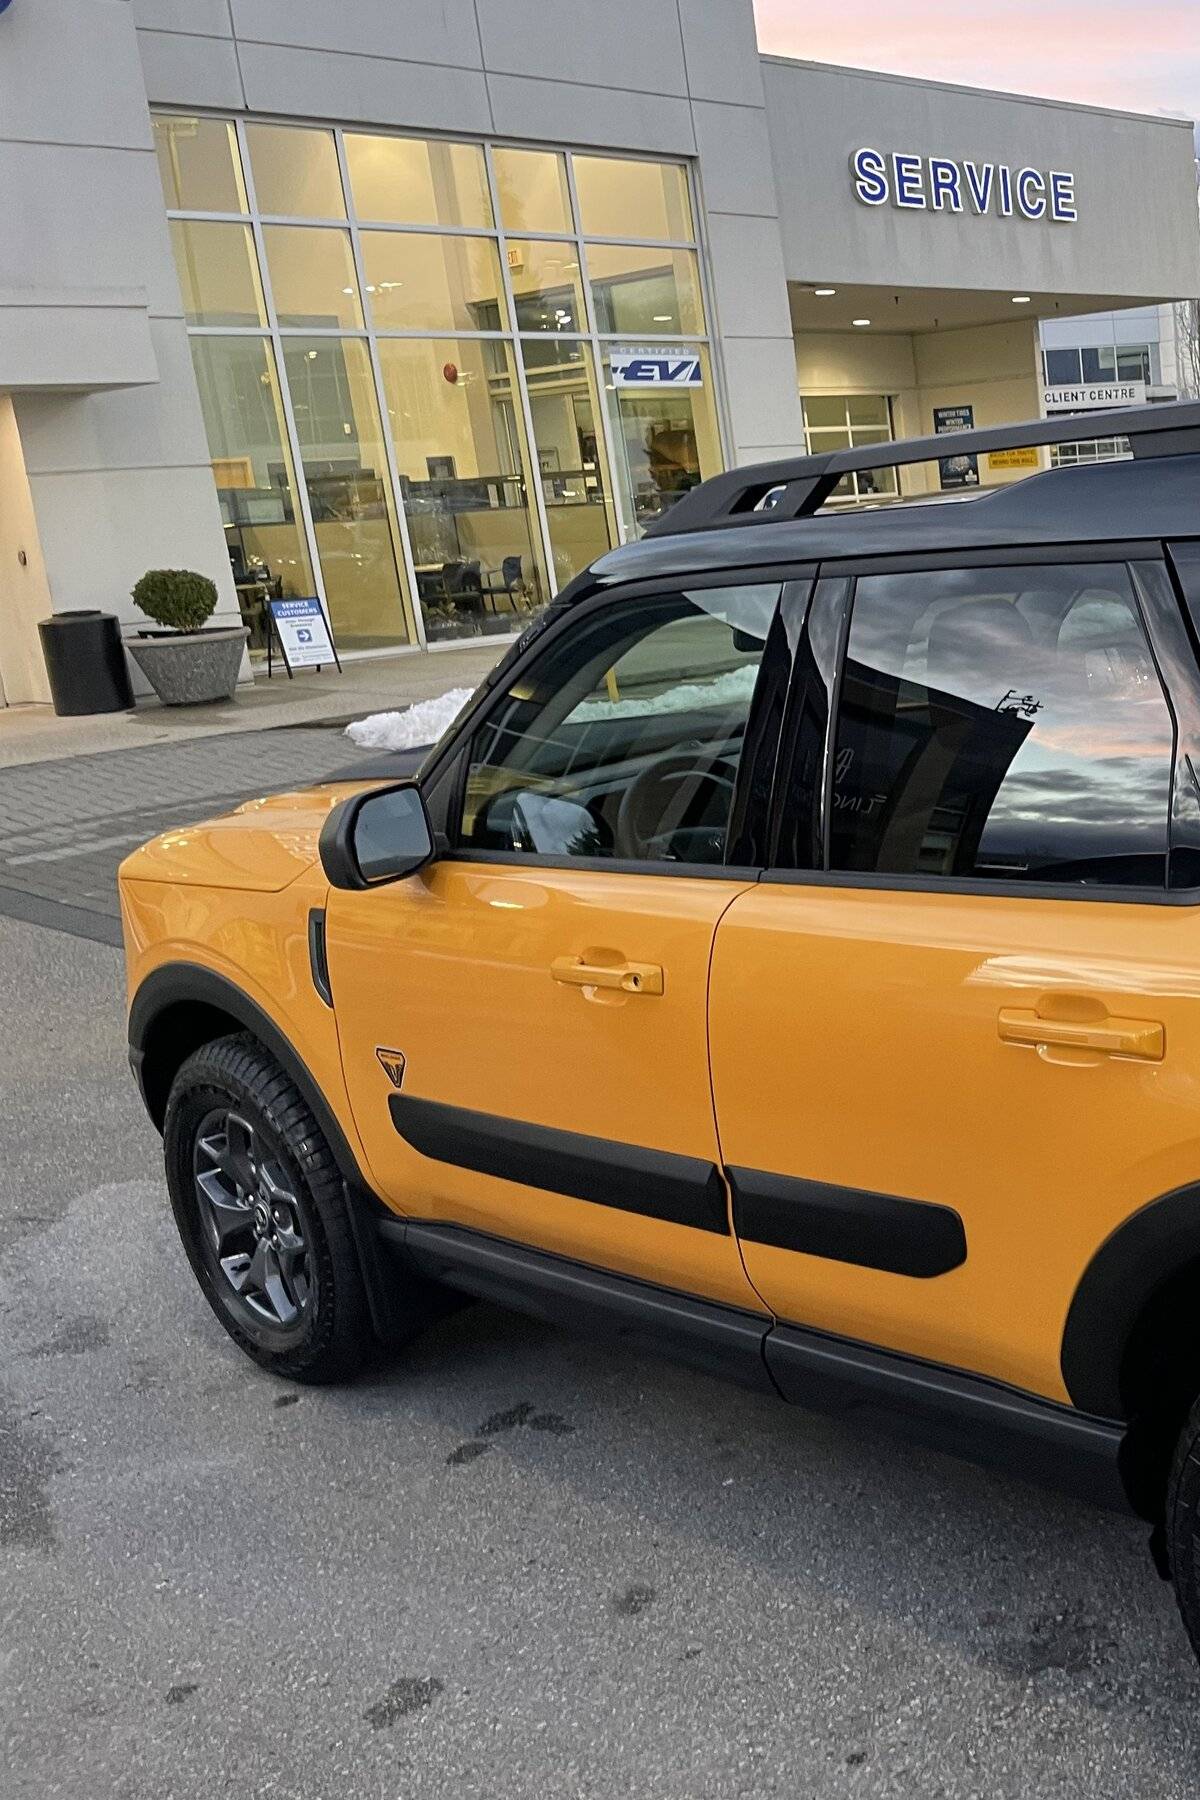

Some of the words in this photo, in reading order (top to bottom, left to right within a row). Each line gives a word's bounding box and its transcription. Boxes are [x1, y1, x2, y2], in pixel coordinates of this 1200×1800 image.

[854, 147, 1078, 222] SERVICE
[1044, 391, 1086, 403] CLIENT
[1089, 388, 1135, 401] CENTRE
[282, 601, 308, 609] SERVICE
[277, 608, 318, 617] CUSTOMERS
